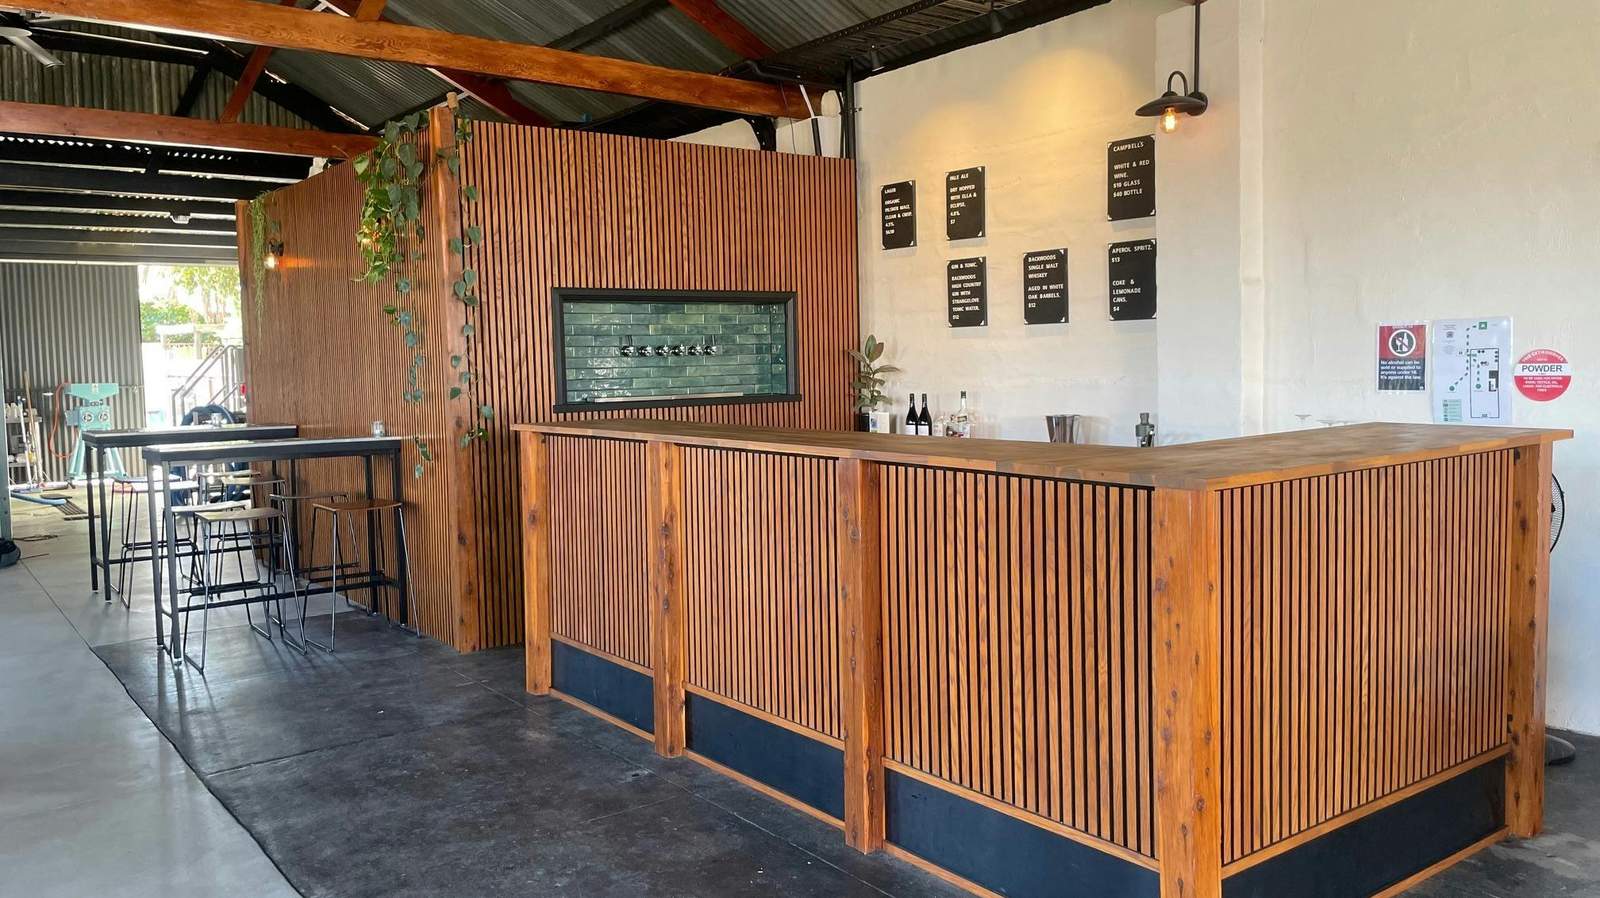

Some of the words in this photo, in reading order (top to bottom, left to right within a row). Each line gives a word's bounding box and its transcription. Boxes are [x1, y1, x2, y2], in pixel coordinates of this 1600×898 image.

[1113, 162, 1130, 170] WHITE
[1123, 179, 1141, 187] GLASS
[1123, 188, 1143, 196] BOTTLE
[1028, 254, 1057, 263] BACKWOODS
[1112, 287, 1142, 295] LEMONADE
[1521, 364, 1563, 373] POWDER
